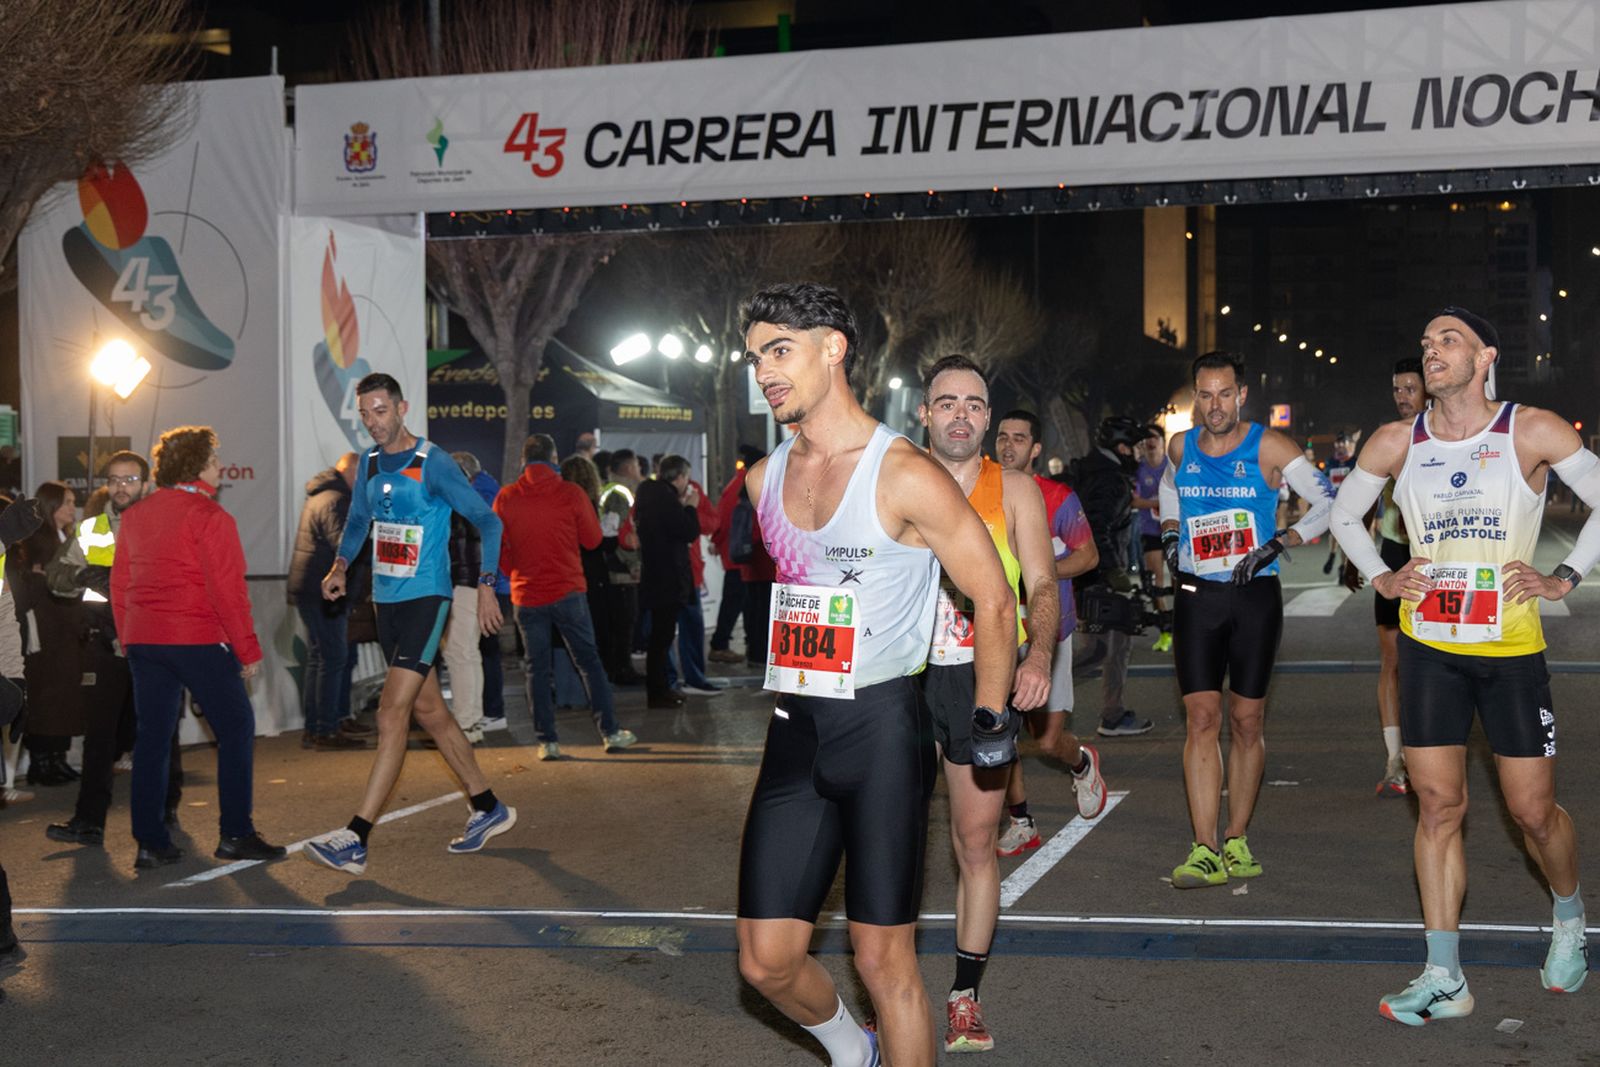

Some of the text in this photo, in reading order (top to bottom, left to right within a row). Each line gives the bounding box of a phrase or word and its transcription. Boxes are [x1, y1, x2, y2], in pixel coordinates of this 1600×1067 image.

[503, 112, 567, 178] 43
[585, 109, 836, 169] CARRERA
[861, 81, 1386, 156] INTERNACIONAL
[110, 256, 179, 330] 43
[428, 402, 556, 421] evedepo.es
[1178, 486, 1257, 498] TROTASIERRA
[1433, 491, 1453, 499] PABLO
[1454, 489, 1484, 498] CARVAJAL
[1445, 509, 1454, 518] DE
[1457, 507, 1502, 517] RUNNING
[1483, 516, 1500, 527] DE
[1457, 571, 1468, 579] DE
[1438, 579, 1468, 589] ANTÓN
[808, 600, 821, 609] DE
[788, 609, 820, 623] ANTÓN
[780, 623, 836, 660] 3184
